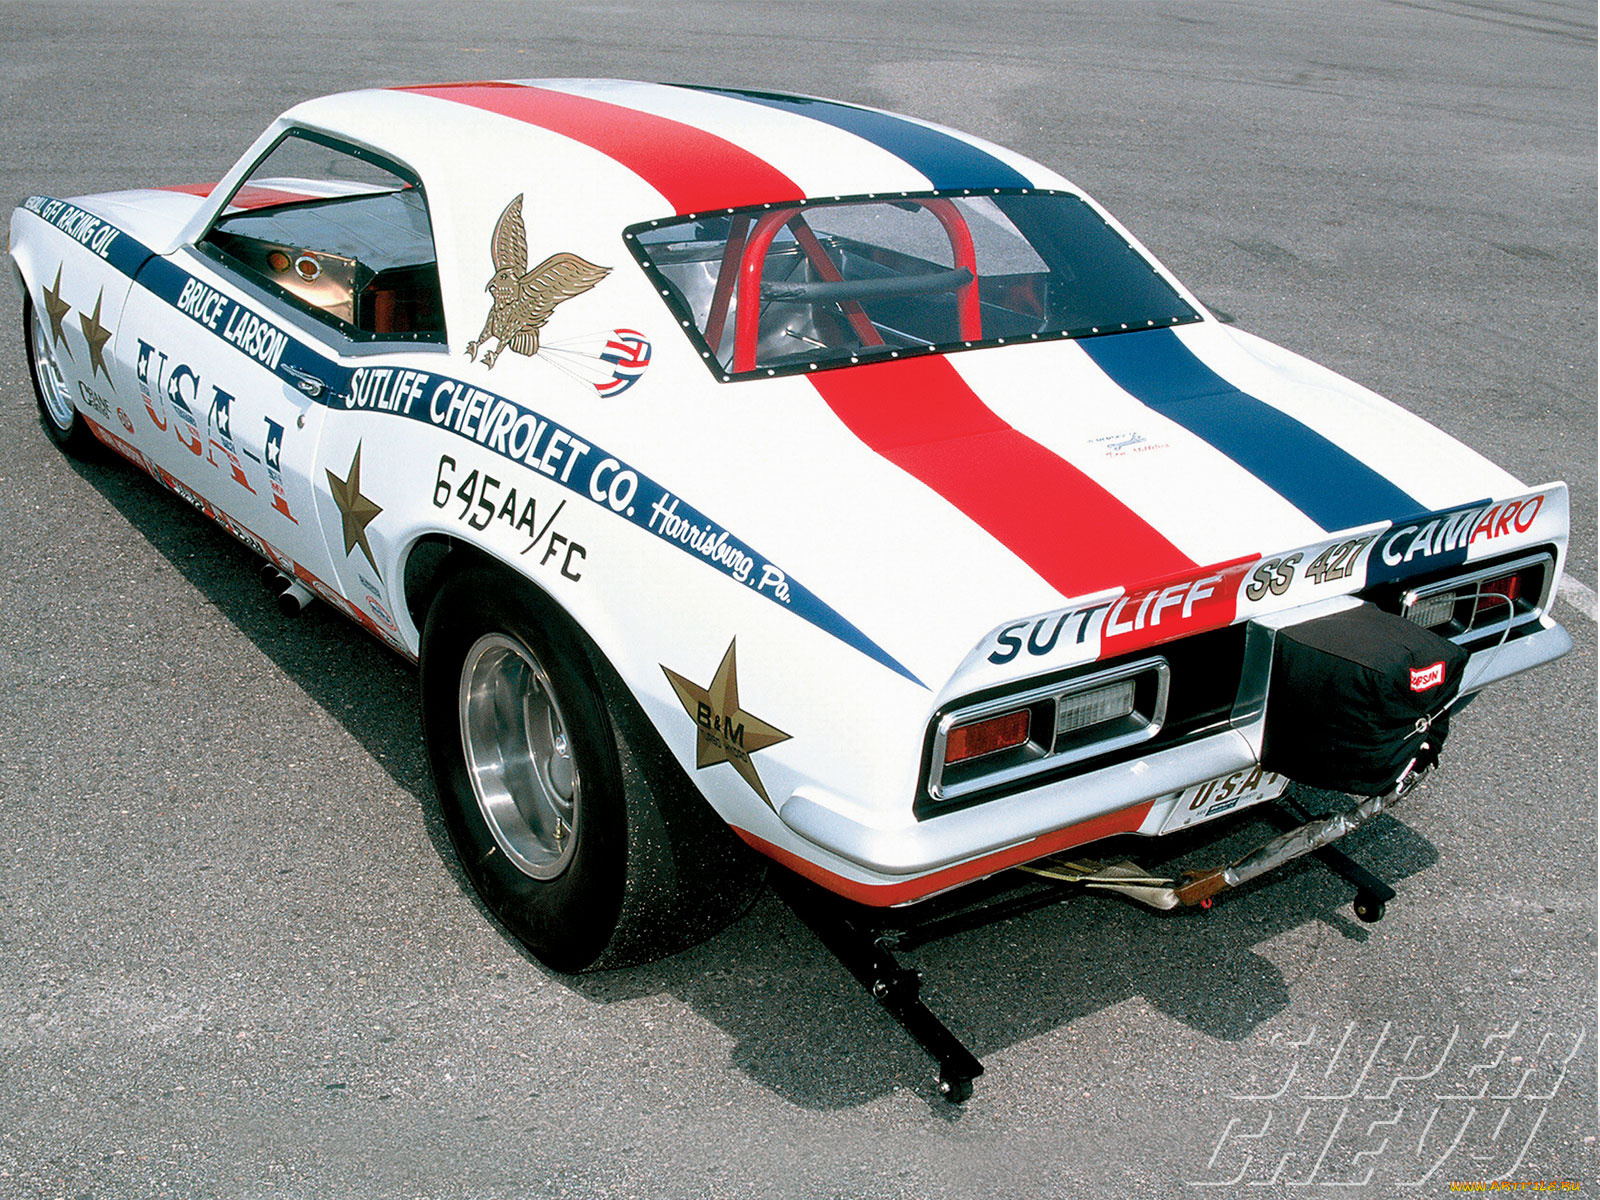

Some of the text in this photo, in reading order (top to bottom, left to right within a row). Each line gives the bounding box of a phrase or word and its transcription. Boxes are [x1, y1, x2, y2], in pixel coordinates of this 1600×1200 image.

[56, 206, 101, 245] RACING
[91, 225, 120, 259] OIL
[177, 277, 290, 370] BRUCE LARSON
[345, 367, 429, 414] SUTLIFF
[430, 381, 591, 483] CHEVROLET
[589, 458, 640, 517] CO.
[756, 564, 792, 604] Pa.
[987, 494, 1545, 665] SUTLIFF SS 427 CAMARO
